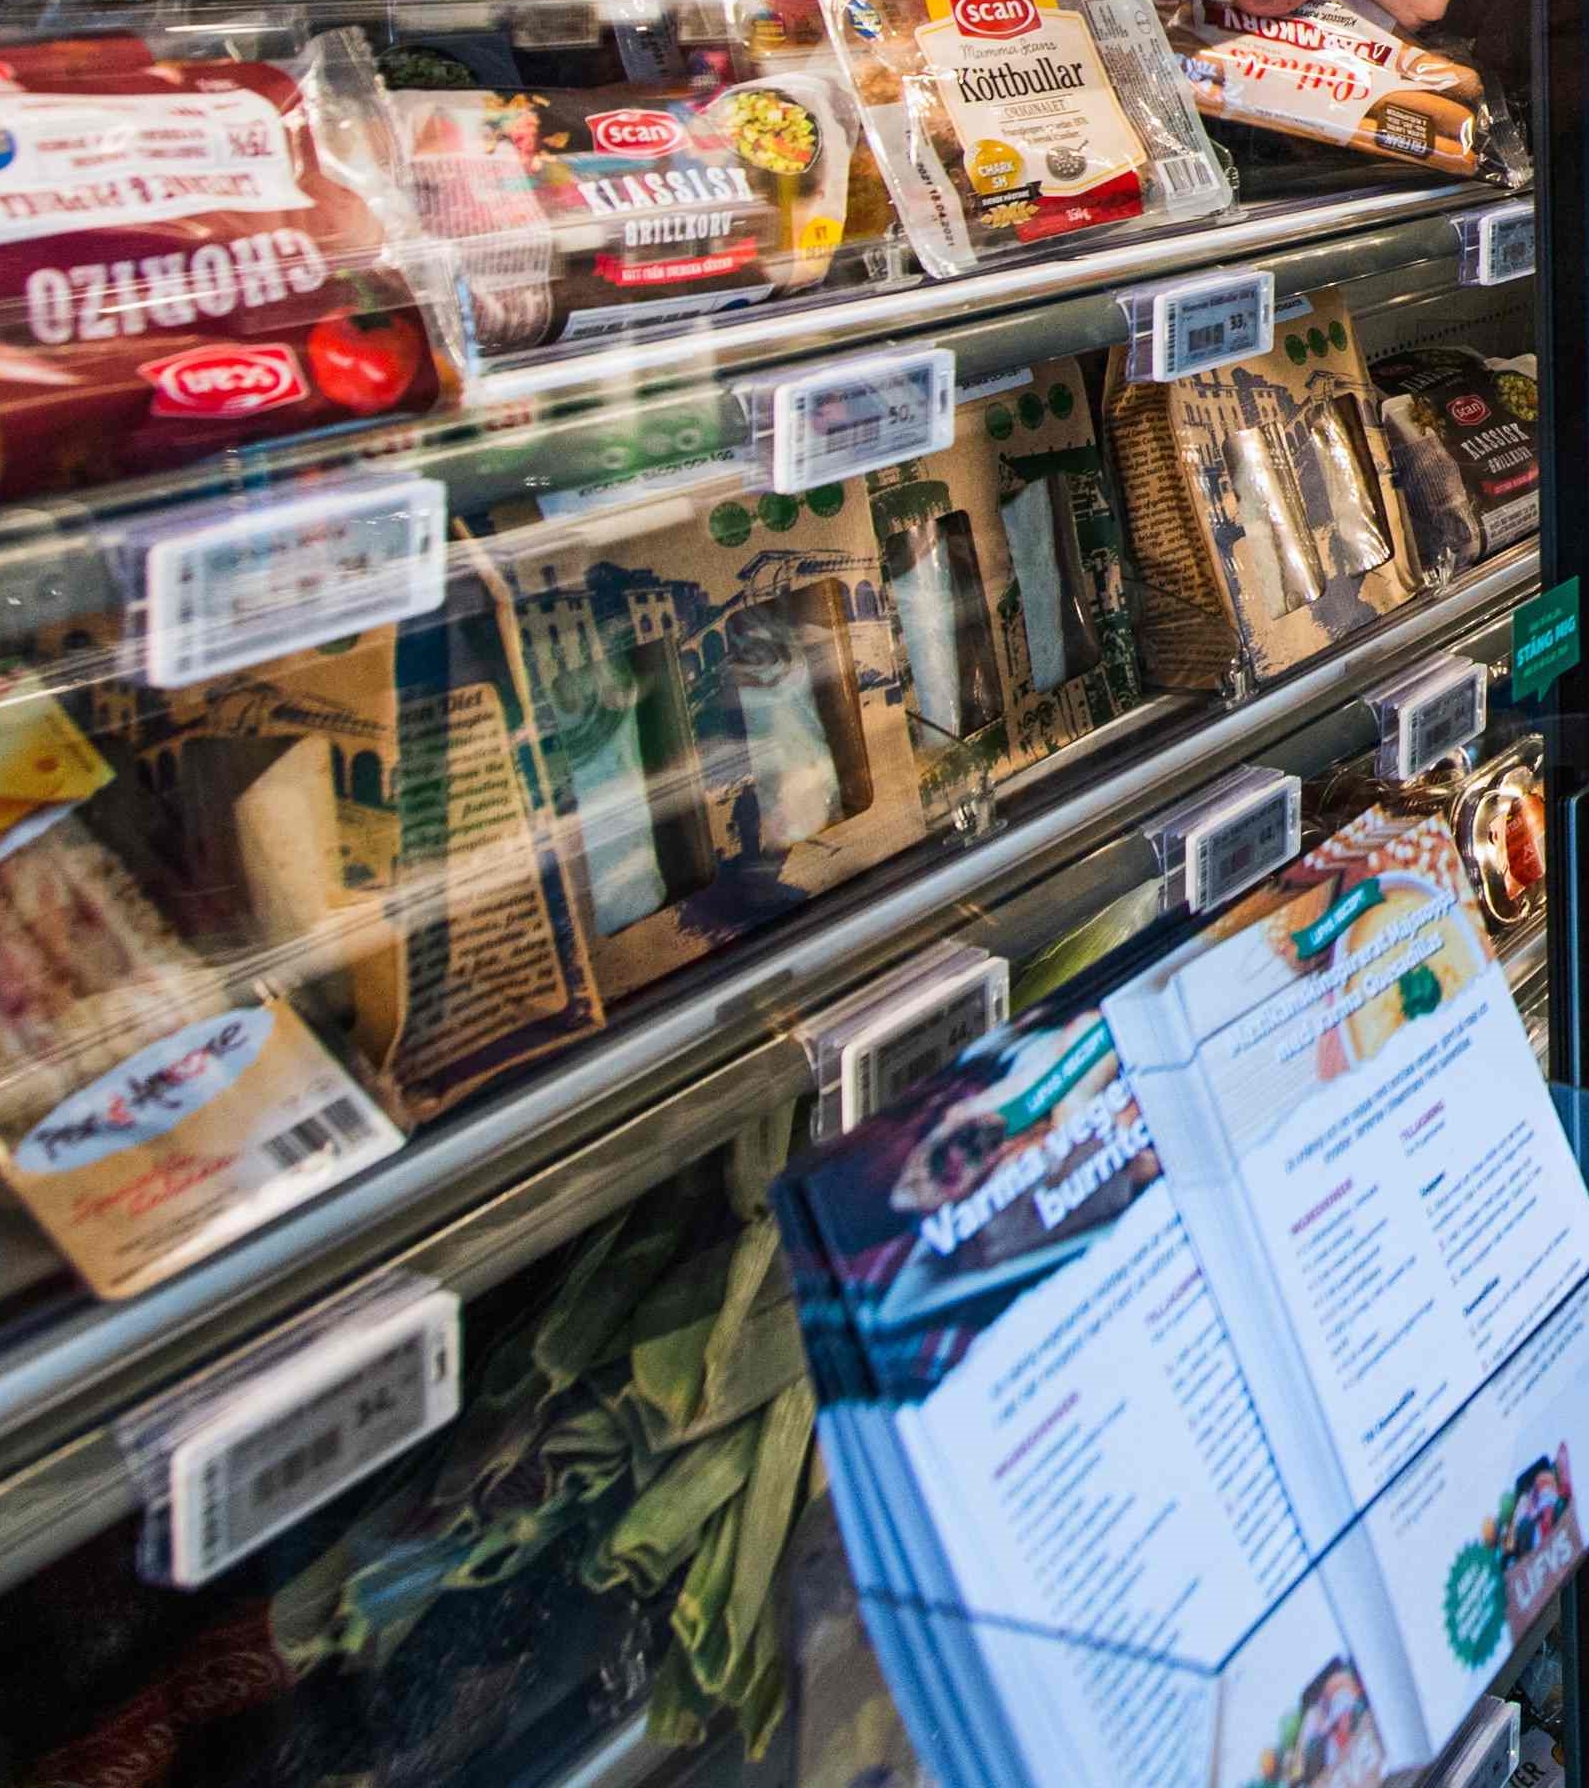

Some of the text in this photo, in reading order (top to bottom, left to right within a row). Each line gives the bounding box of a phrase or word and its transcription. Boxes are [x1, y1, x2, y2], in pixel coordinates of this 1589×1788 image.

[965, 0, 1024, 22] scan
[953, 57, 1087, 104] Köttbullar
[609, 123, 668, 144] scan
[576, 166, 756, 214] KLASSISK
[624, 211, 733, 248] GRILLKORV
[26, 229, 327, 345] CHORIZO
[179, 362, 273, 392] scan
[1460, 421, 1531, 461] KLASSISK
[919, 1144, 1047, 1258] Varma
